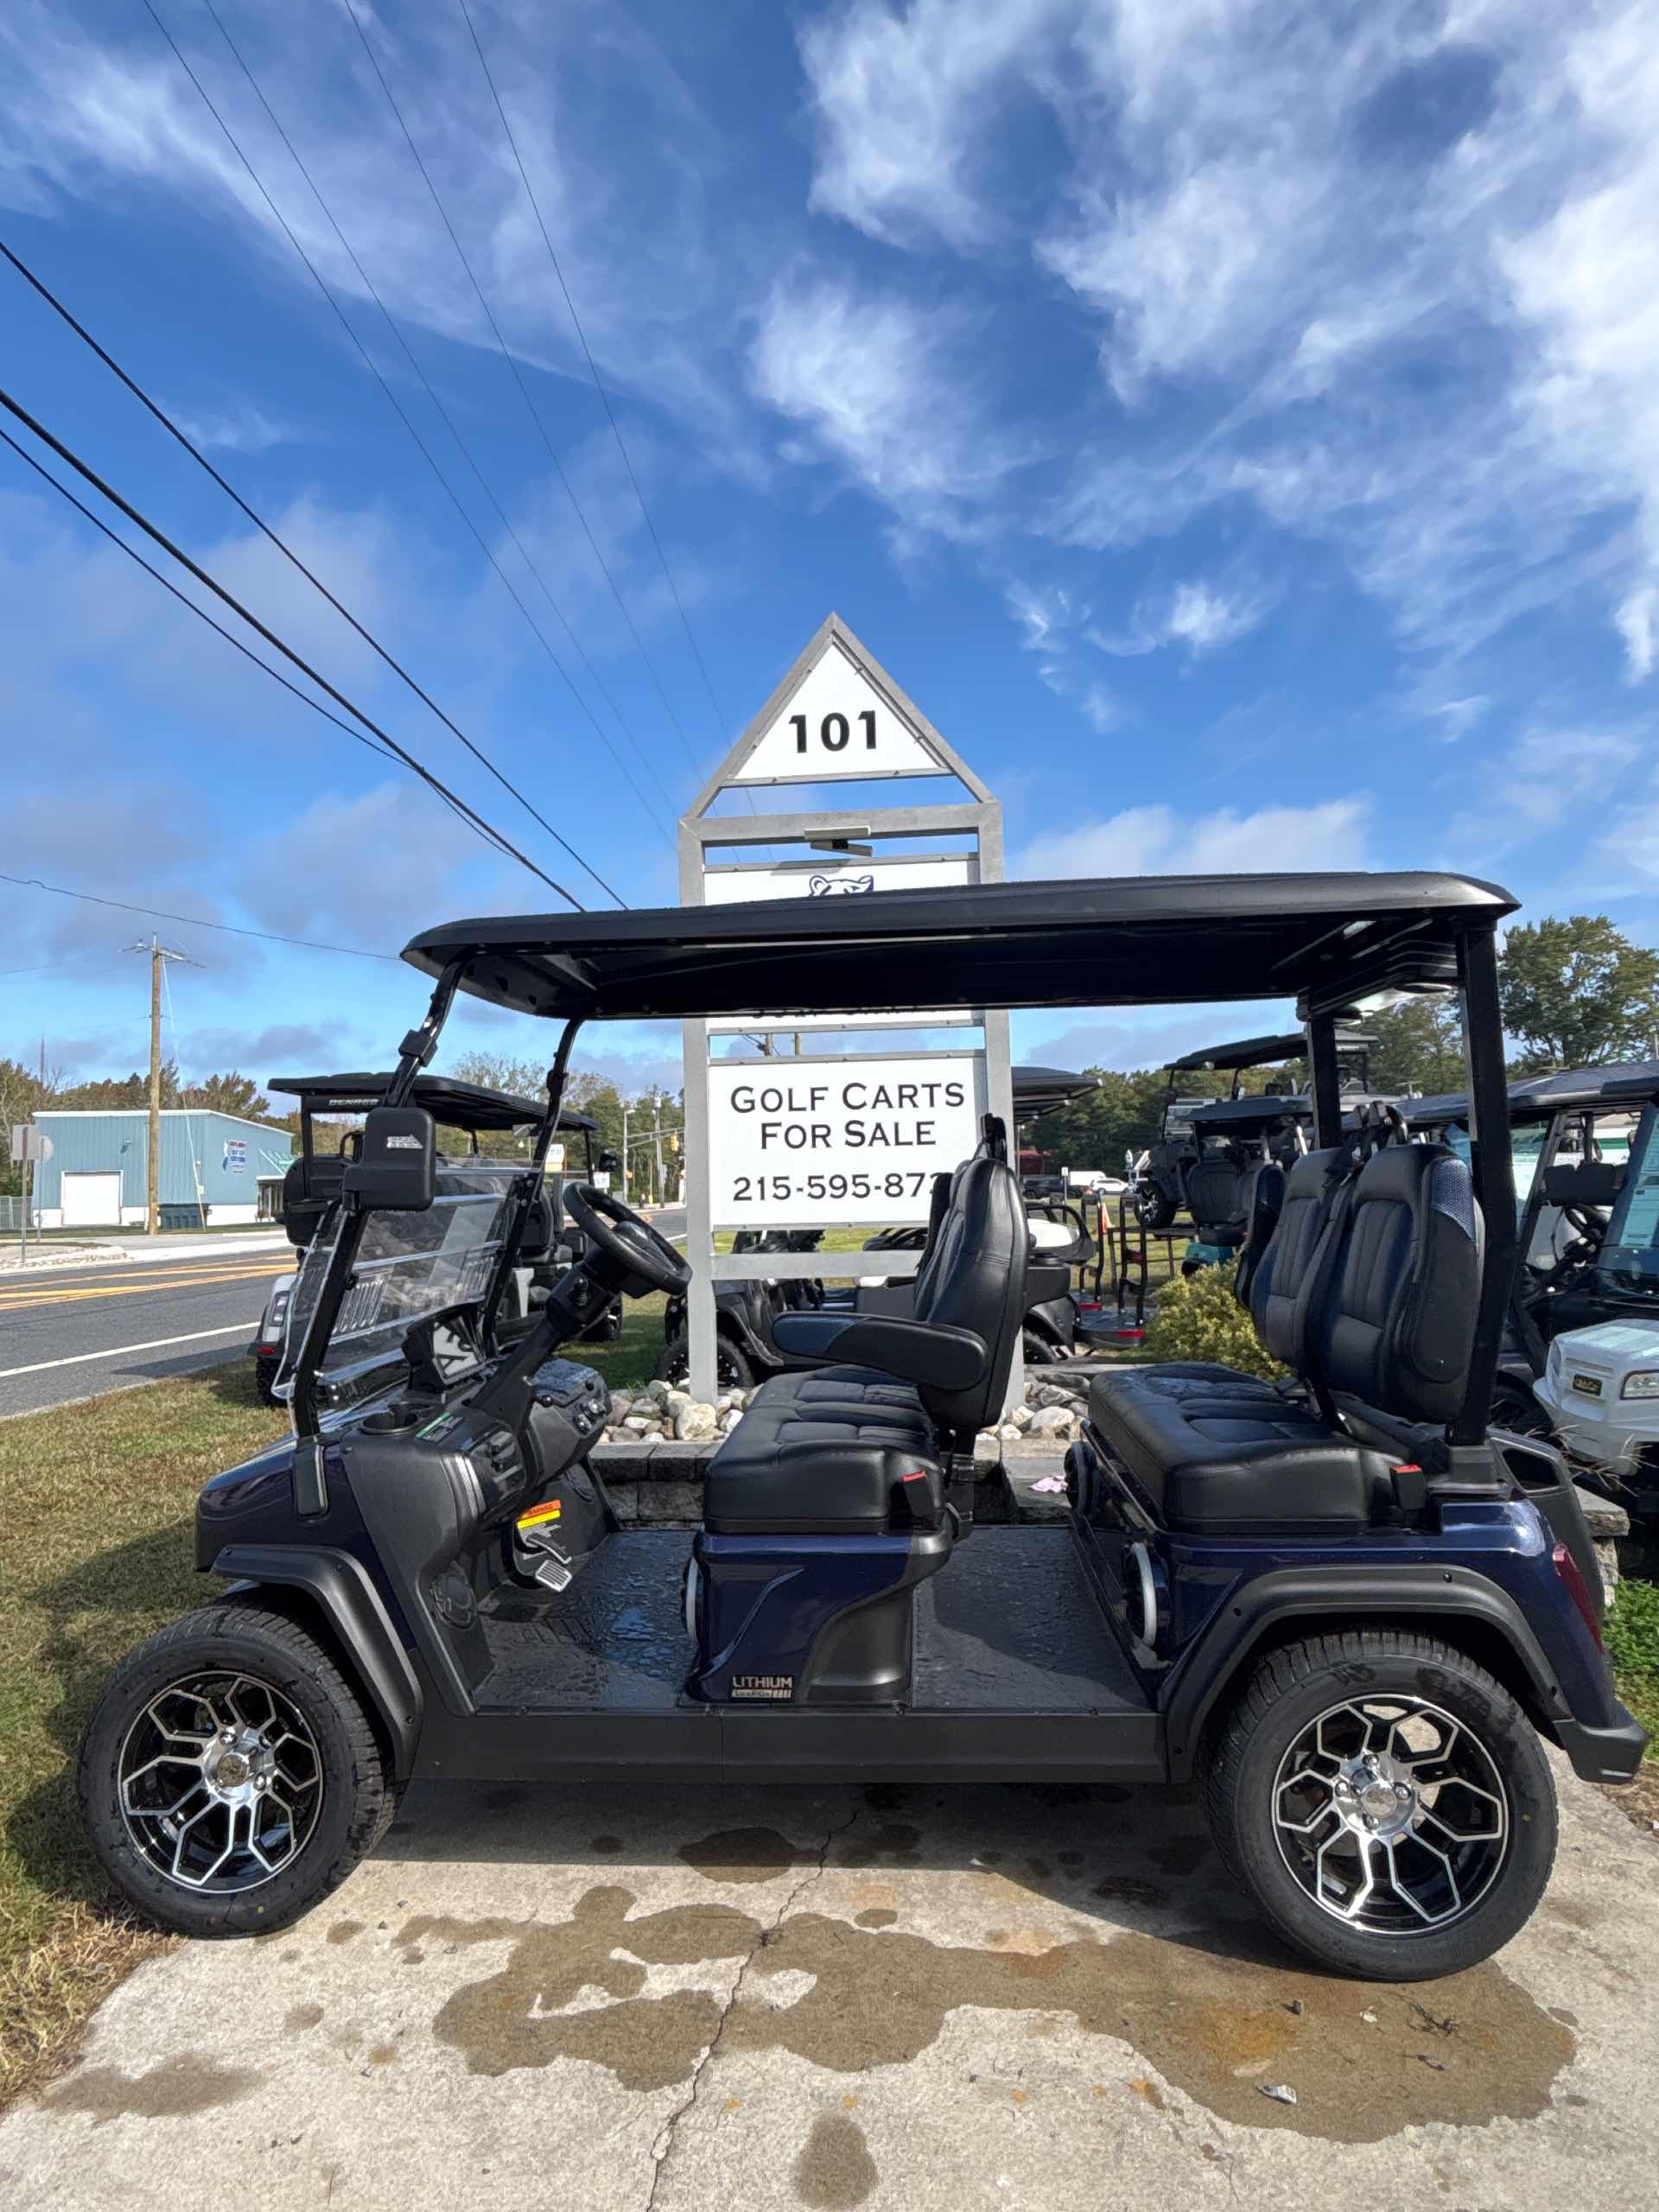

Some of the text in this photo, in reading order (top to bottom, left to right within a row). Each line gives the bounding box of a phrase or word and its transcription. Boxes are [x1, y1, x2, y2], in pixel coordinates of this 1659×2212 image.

[788, 709, 878, 754] 101
[730, 1082, 965, 1114] GOLF CARTS
[760, 1119, 937, 1150] FOR SALE
[732, 1675, 793, 1688] LITHIUM
